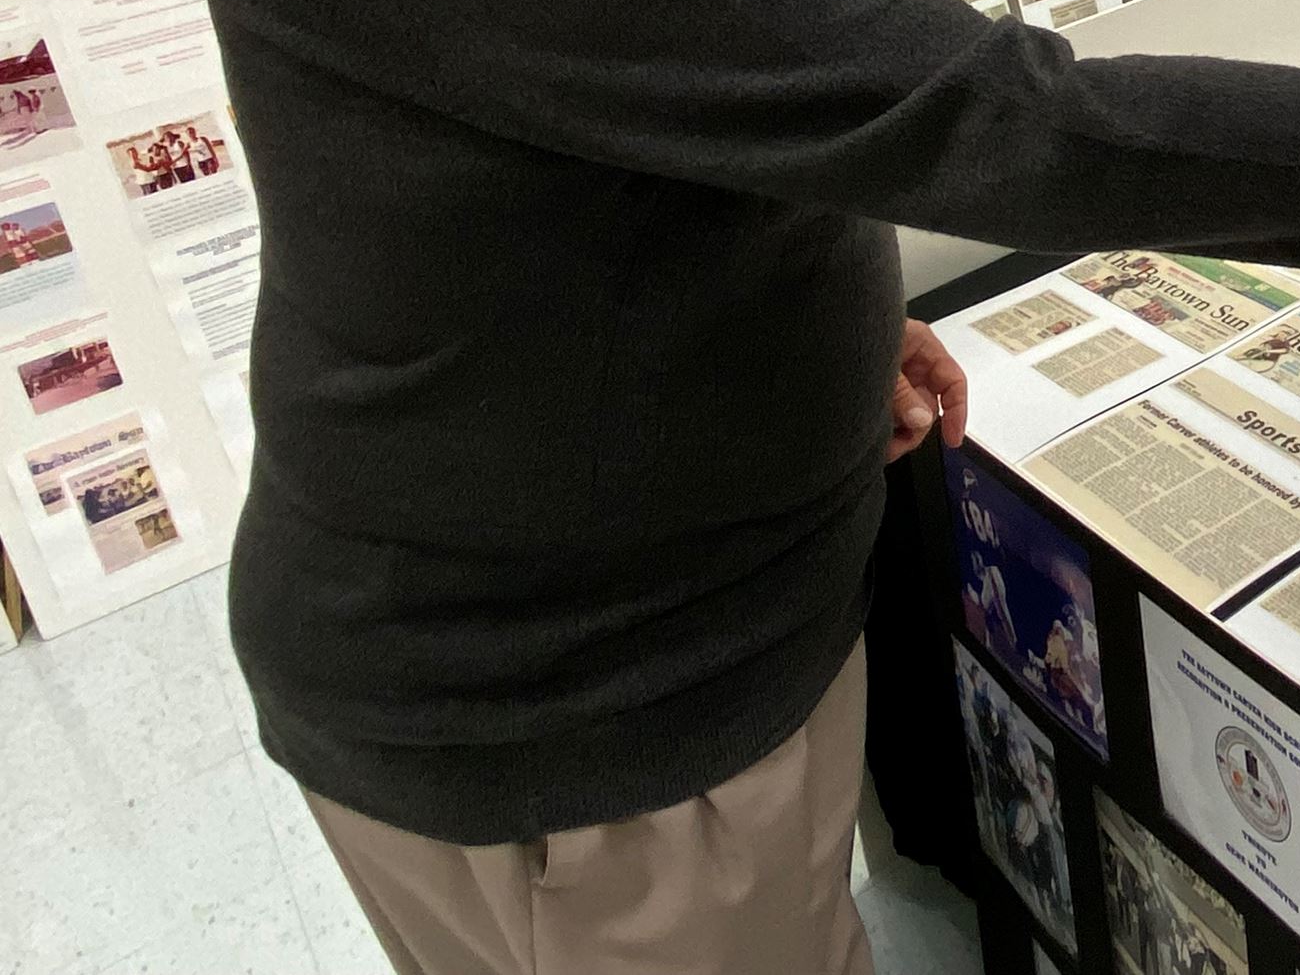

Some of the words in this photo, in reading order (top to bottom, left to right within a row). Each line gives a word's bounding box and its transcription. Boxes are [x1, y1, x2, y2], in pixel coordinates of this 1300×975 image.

[1134, 265, 1211, 313] Baytown
[1210, 304, 1251, 332] Sun
[1137, 399, 1169, 420] Former
[1166, 417, 1196, 439] Carver
[1193, 436, 1230, 462] athletes
[1228, 457, 1239, 468] to
[1239, 464, 1252, 476] be
[1251, 472, 1292, 502] honored
[1182, 649, 1195, 667] THE
[1197, 661, 1231, 695] BAYTOWN
[1233, 690, 1262, 719] CARVER
[1263, 714, 1282, 737] HIGH
[1231, 703, 1287, 757] PRESERVATION
[1241, 829, 1277, 866] TRIBUTE
[1255, 854, 1267, 870] TO
